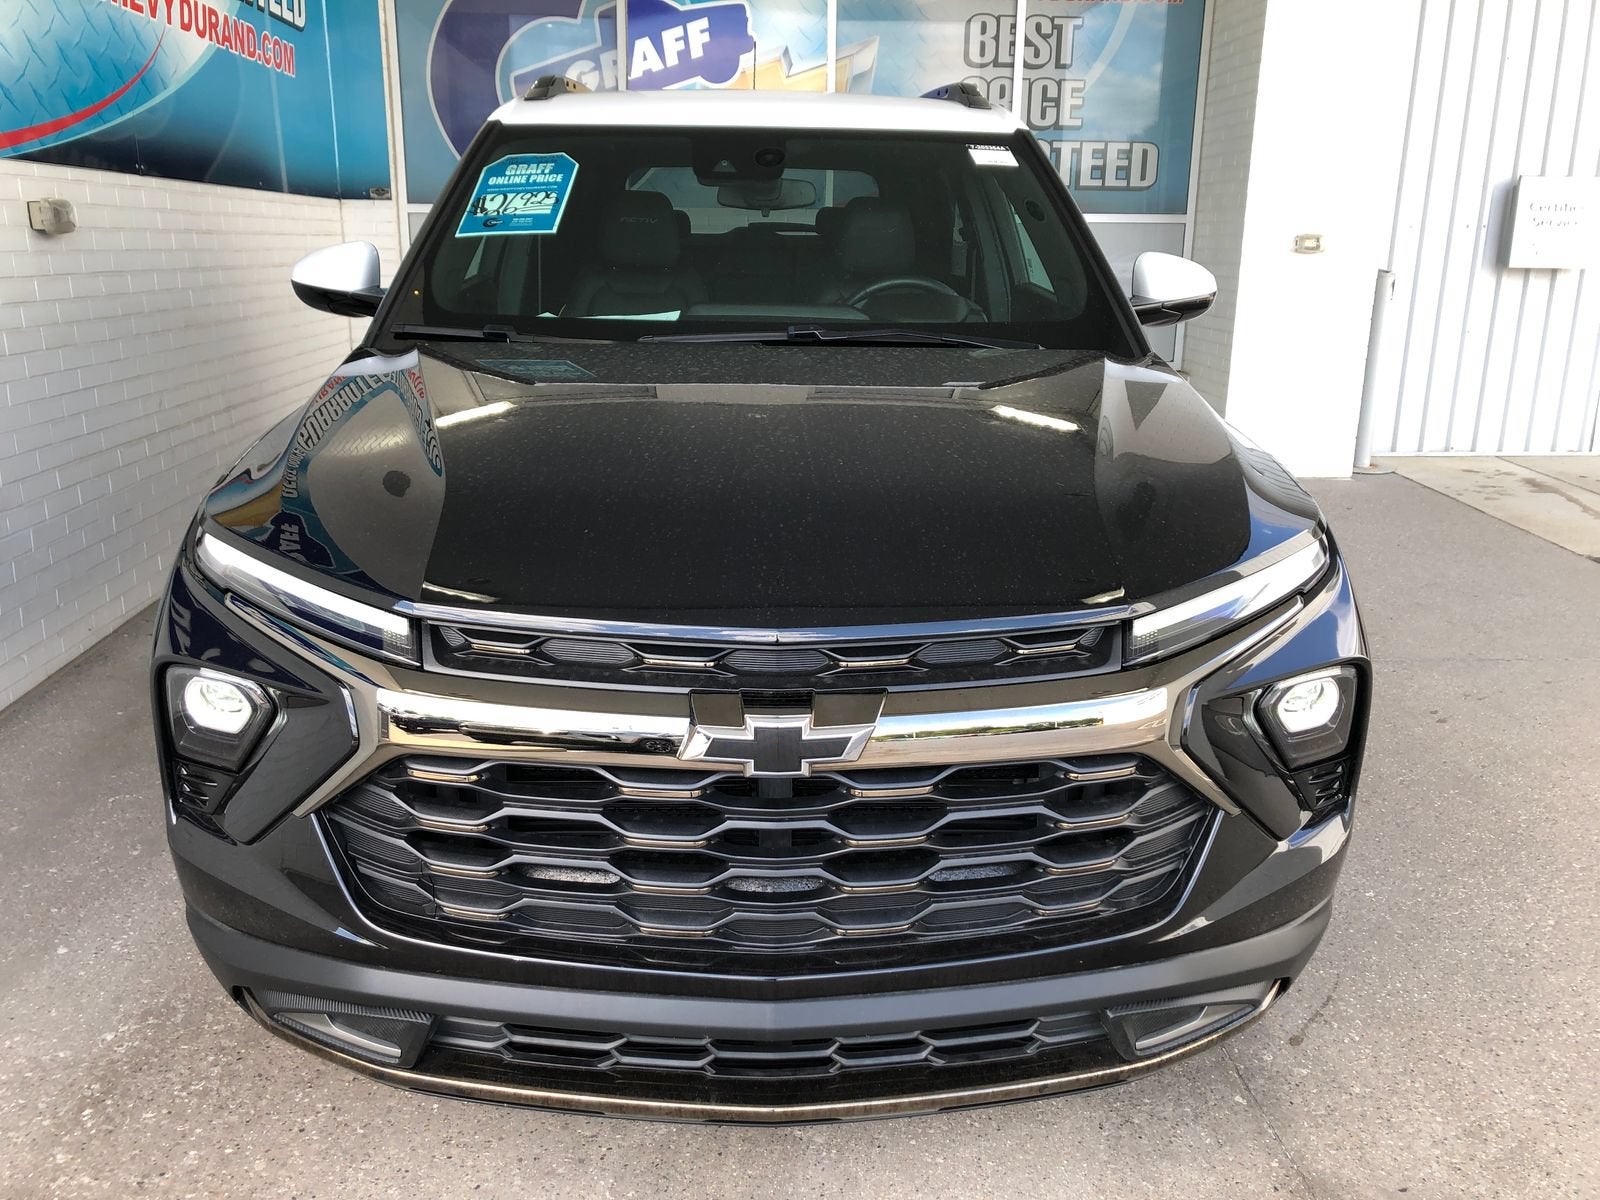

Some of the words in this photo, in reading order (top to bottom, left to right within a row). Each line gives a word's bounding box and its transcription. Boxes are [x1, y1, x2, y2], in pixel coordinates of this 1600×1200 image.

[964, 13, 1084, 70] BEST
[488, 174, 527, 185] ONLINE
[529, 173, 564, 183] PRICE
[505, 163, 555, 176] GRAFF
[1038, 140, 1159, 191] TEED
